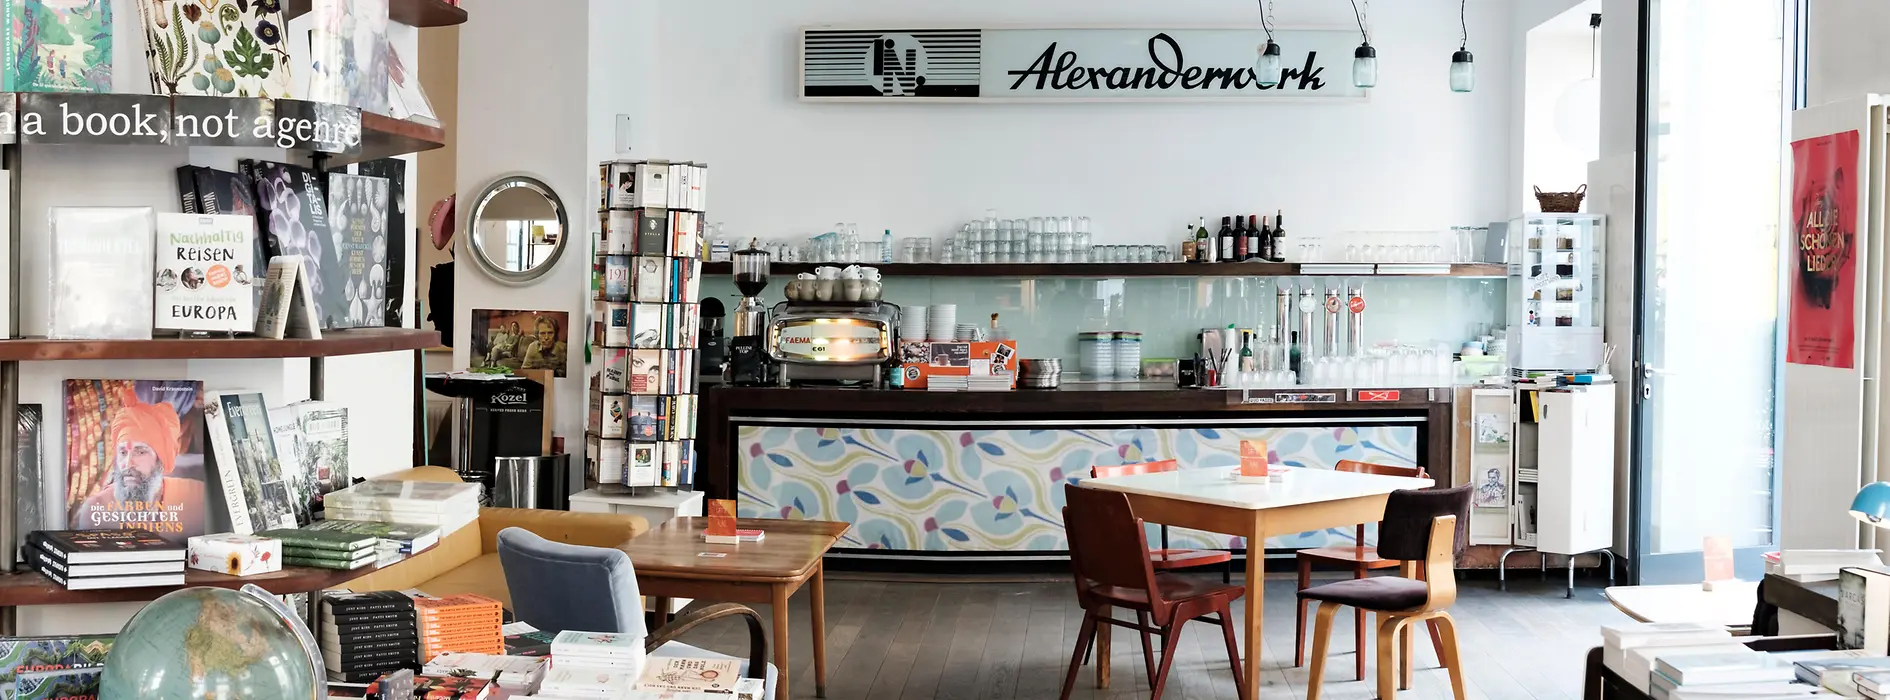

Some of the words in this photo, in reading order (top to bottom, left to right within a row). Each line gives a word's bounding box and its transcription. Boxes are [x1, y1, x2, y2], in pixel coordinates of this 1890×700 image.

[1008, 32, 1326, 91] Alexanderwrk
[59, 102, 168, 143] book,
[176, 108, 240, 138] not
[1806, 211, 1824, 228] ALL
[170, 230, 244, 246] Nachhaltig
[172, 304, 236, 320] EUROPA
[491, 393, 527, 404] Kozel
[224, 470, 244, 526] EVERGREEN
[167, 503, 183, 511] und
[91, 511, 178, 526] GESICHTER
